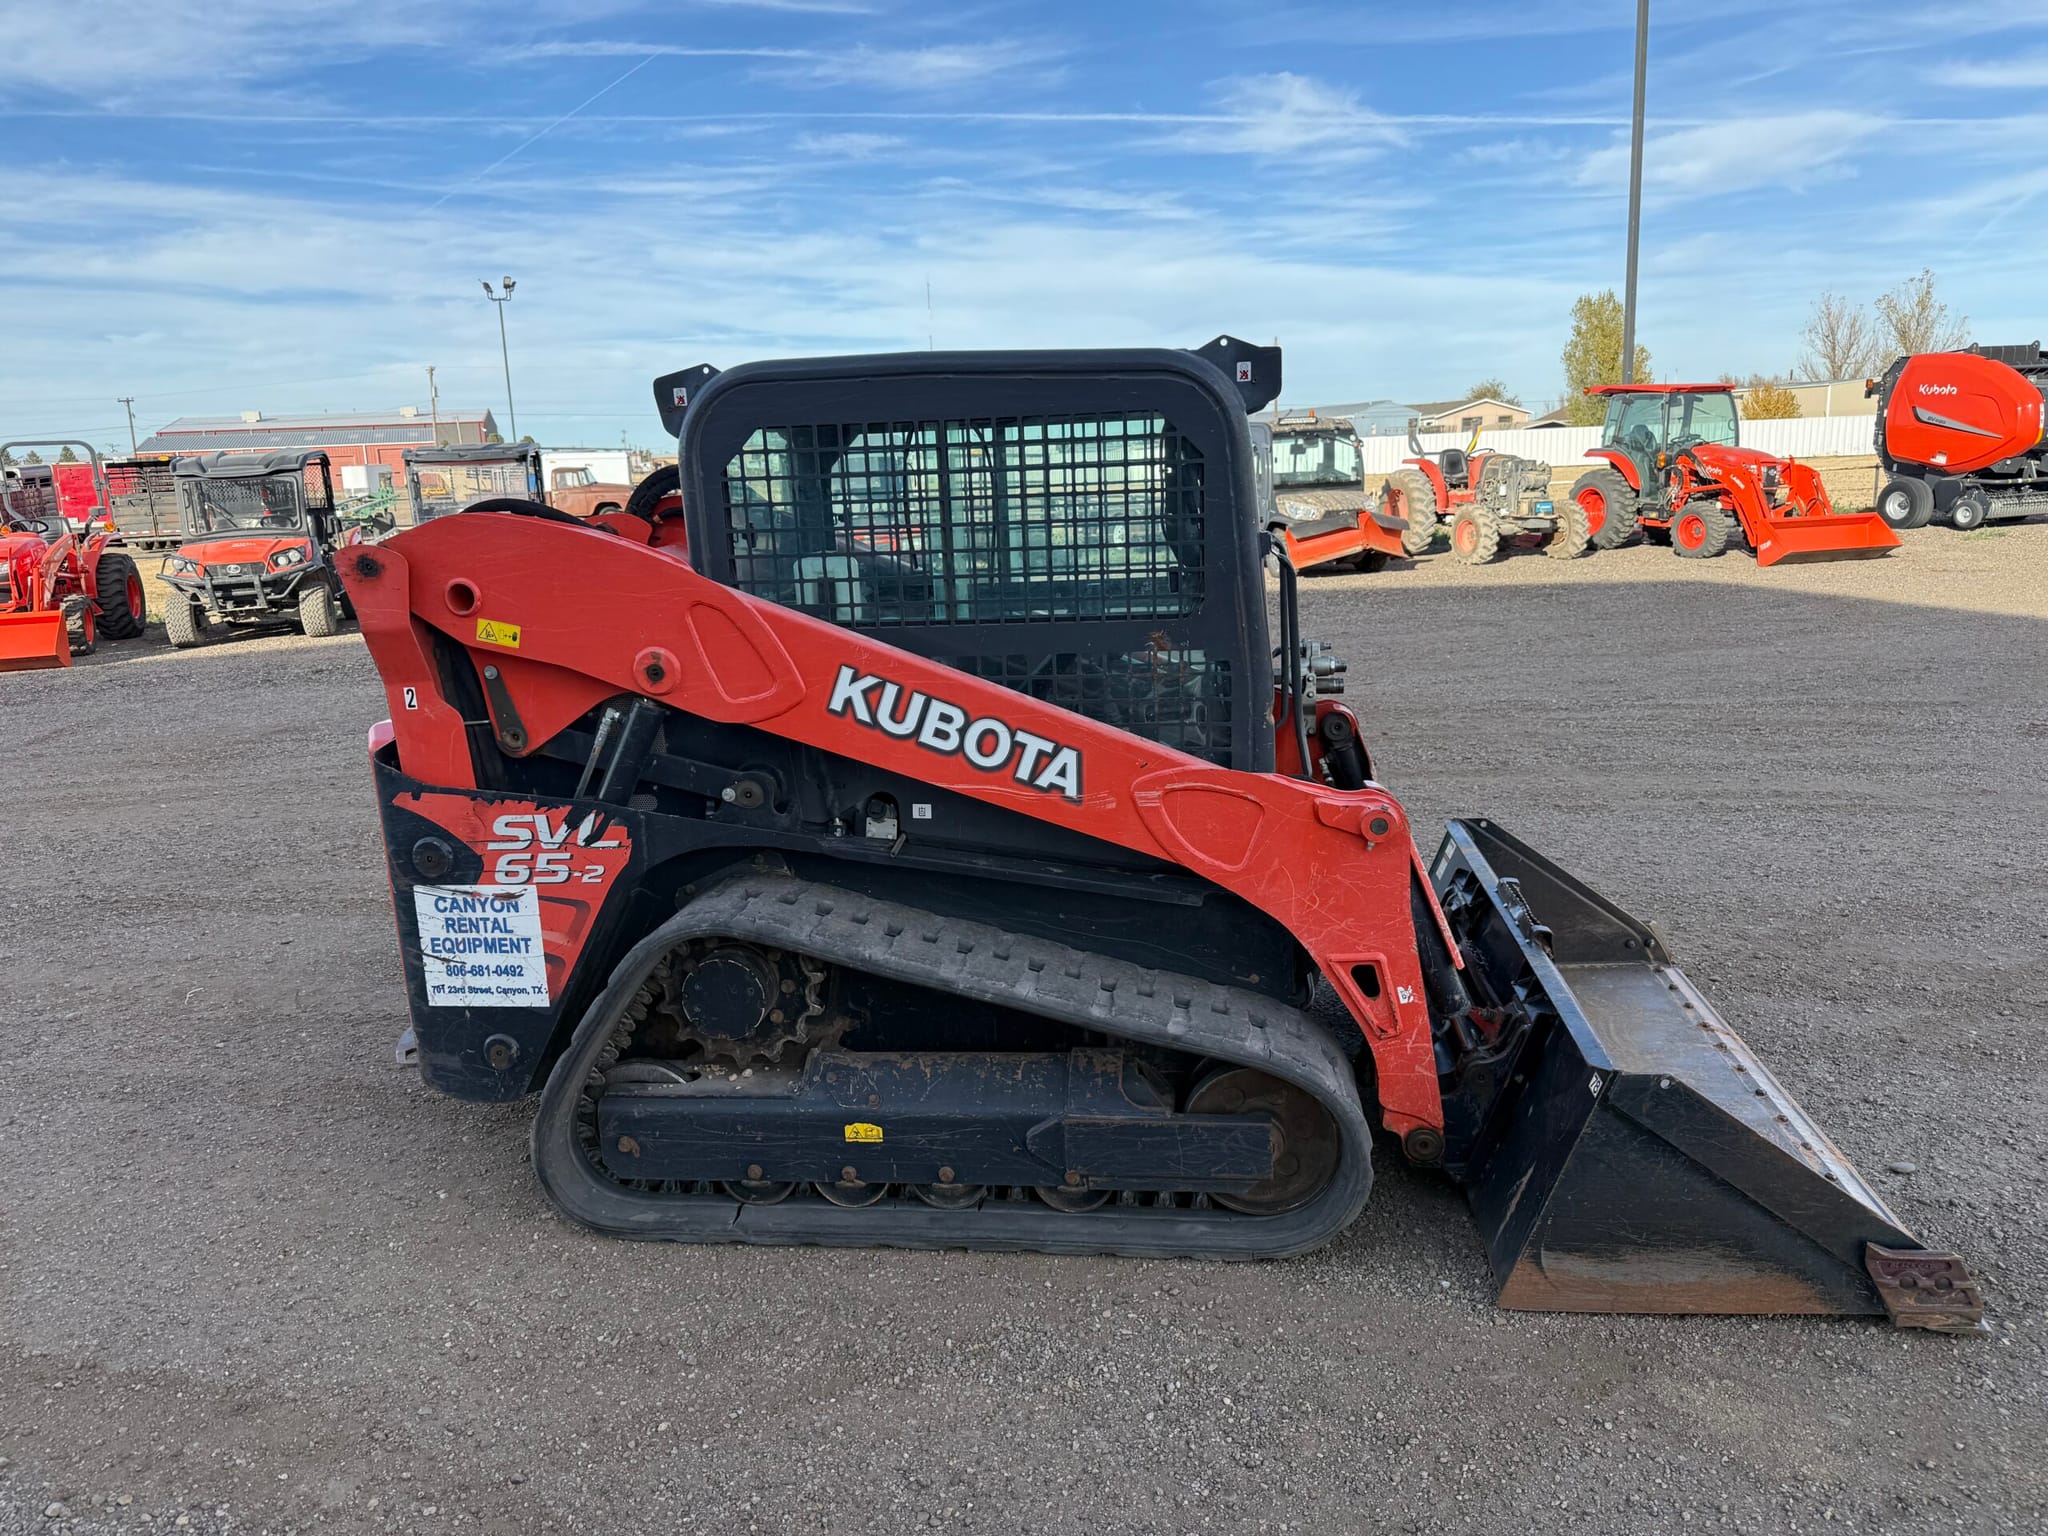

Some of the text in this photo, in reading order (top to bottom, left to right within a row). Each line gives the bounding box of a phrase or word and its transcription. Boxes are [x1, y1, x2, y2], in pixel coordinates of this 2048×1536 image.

[1919, 384, 1958, 395] Kubota
[406, 688, 417, 708] 2
[827, 664, 1081, 802] KUBOTA
[487, 814, 621, 850] SVL
[494, 852, 605, 885] 65-2
[434, 896, 520, 913] CANYON
[444, 917, 514, 934] RENTAL
[430, 937, 532, 954] EQUIPMENT
[445, 964, 525, 977] 806-681-0492
[447, 985, 466, 995] 23rd
[467, 985, 494, 996] Street,
[495, 985, 530, 997] Canyon,
